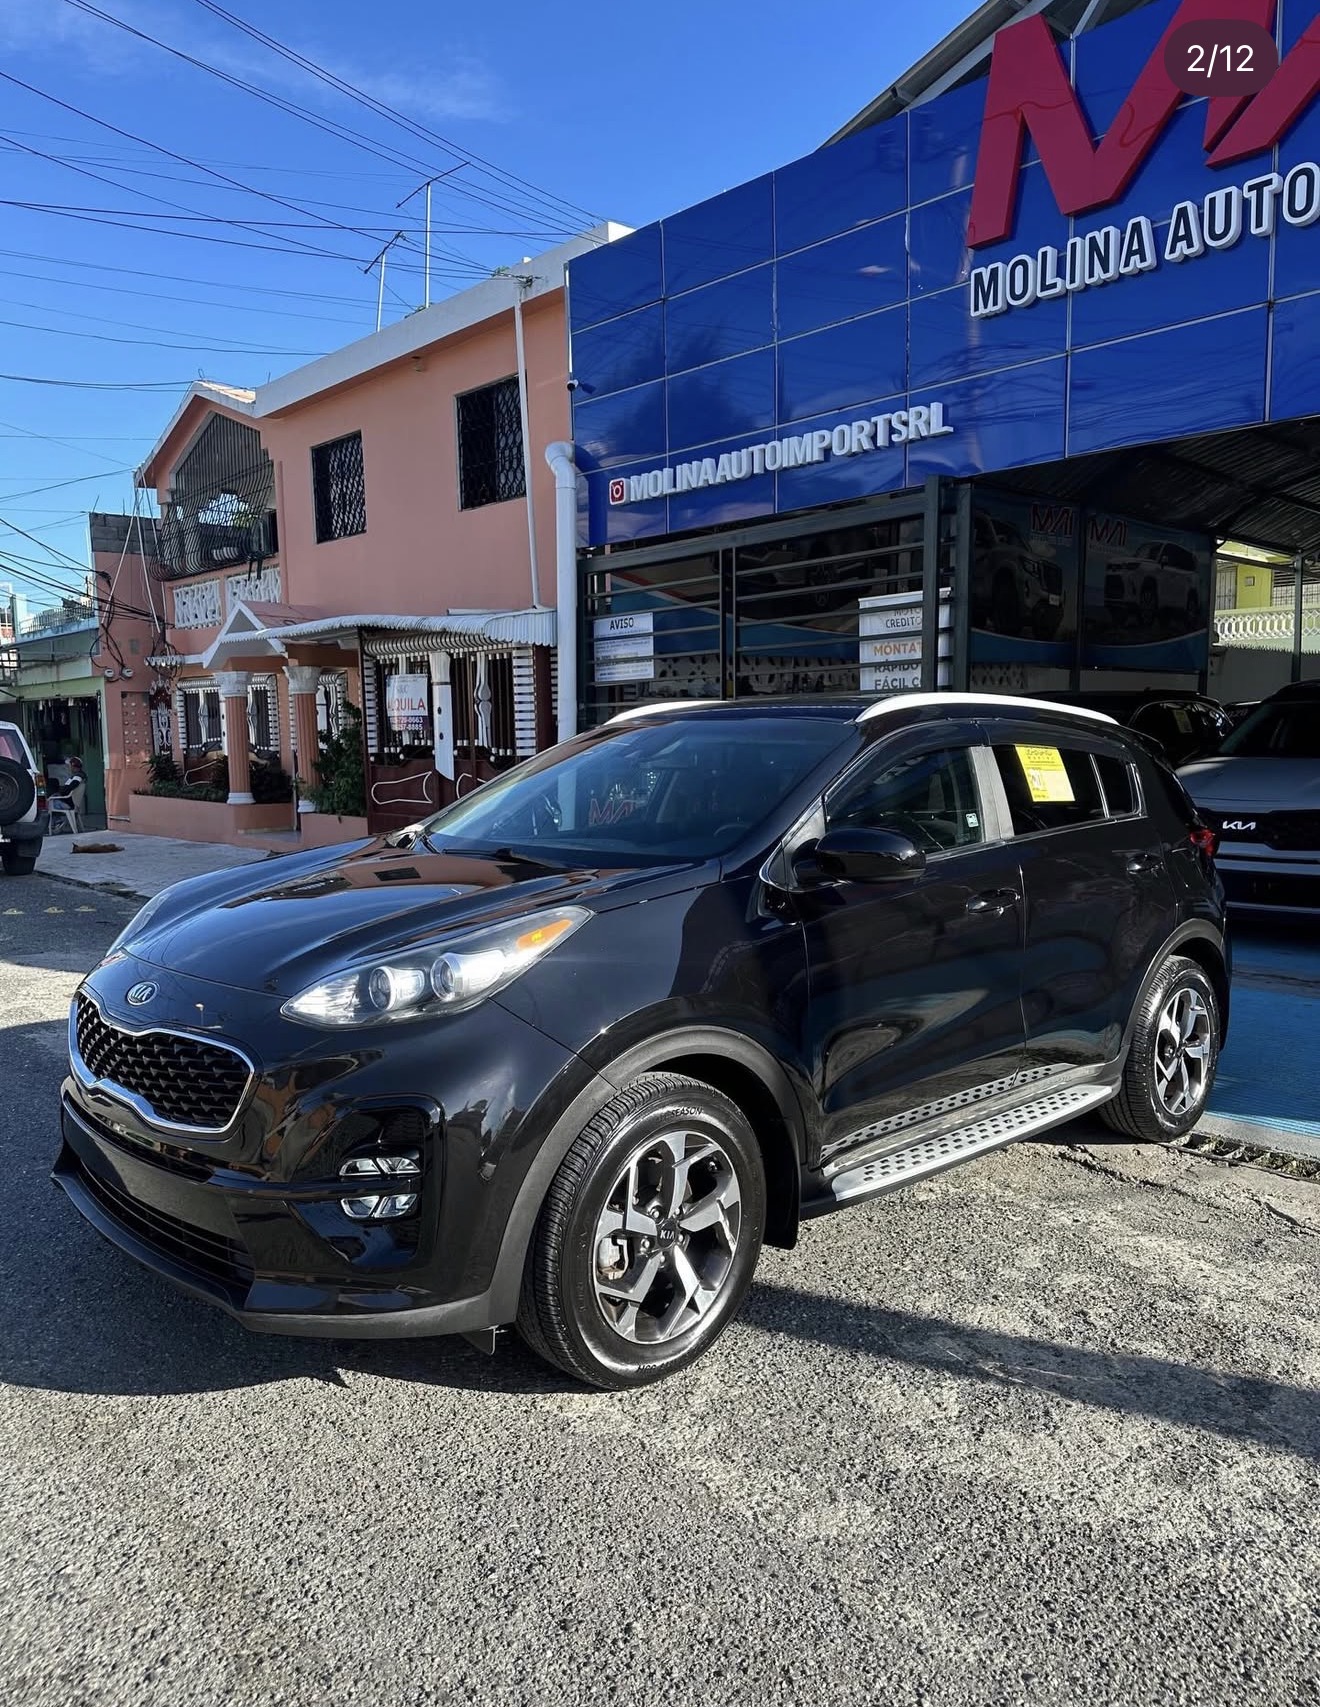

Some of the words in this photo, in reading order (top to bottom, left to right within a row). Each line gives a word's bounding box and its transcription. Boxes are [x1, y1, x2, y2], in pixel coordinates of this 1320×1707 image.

[970, 215, 1156, 317] MOLINA
[1164, 161, 1320, 262] AUTO
[629, 402, 954, 502] MOLINAAUTOIMPORTSRL
[610, 617, 634, 631] AVISO
[911, 677, 921, 688] C
[671, 1105, 704, 1117] SEASON
[660, 1229, 675, 1240] KIA
